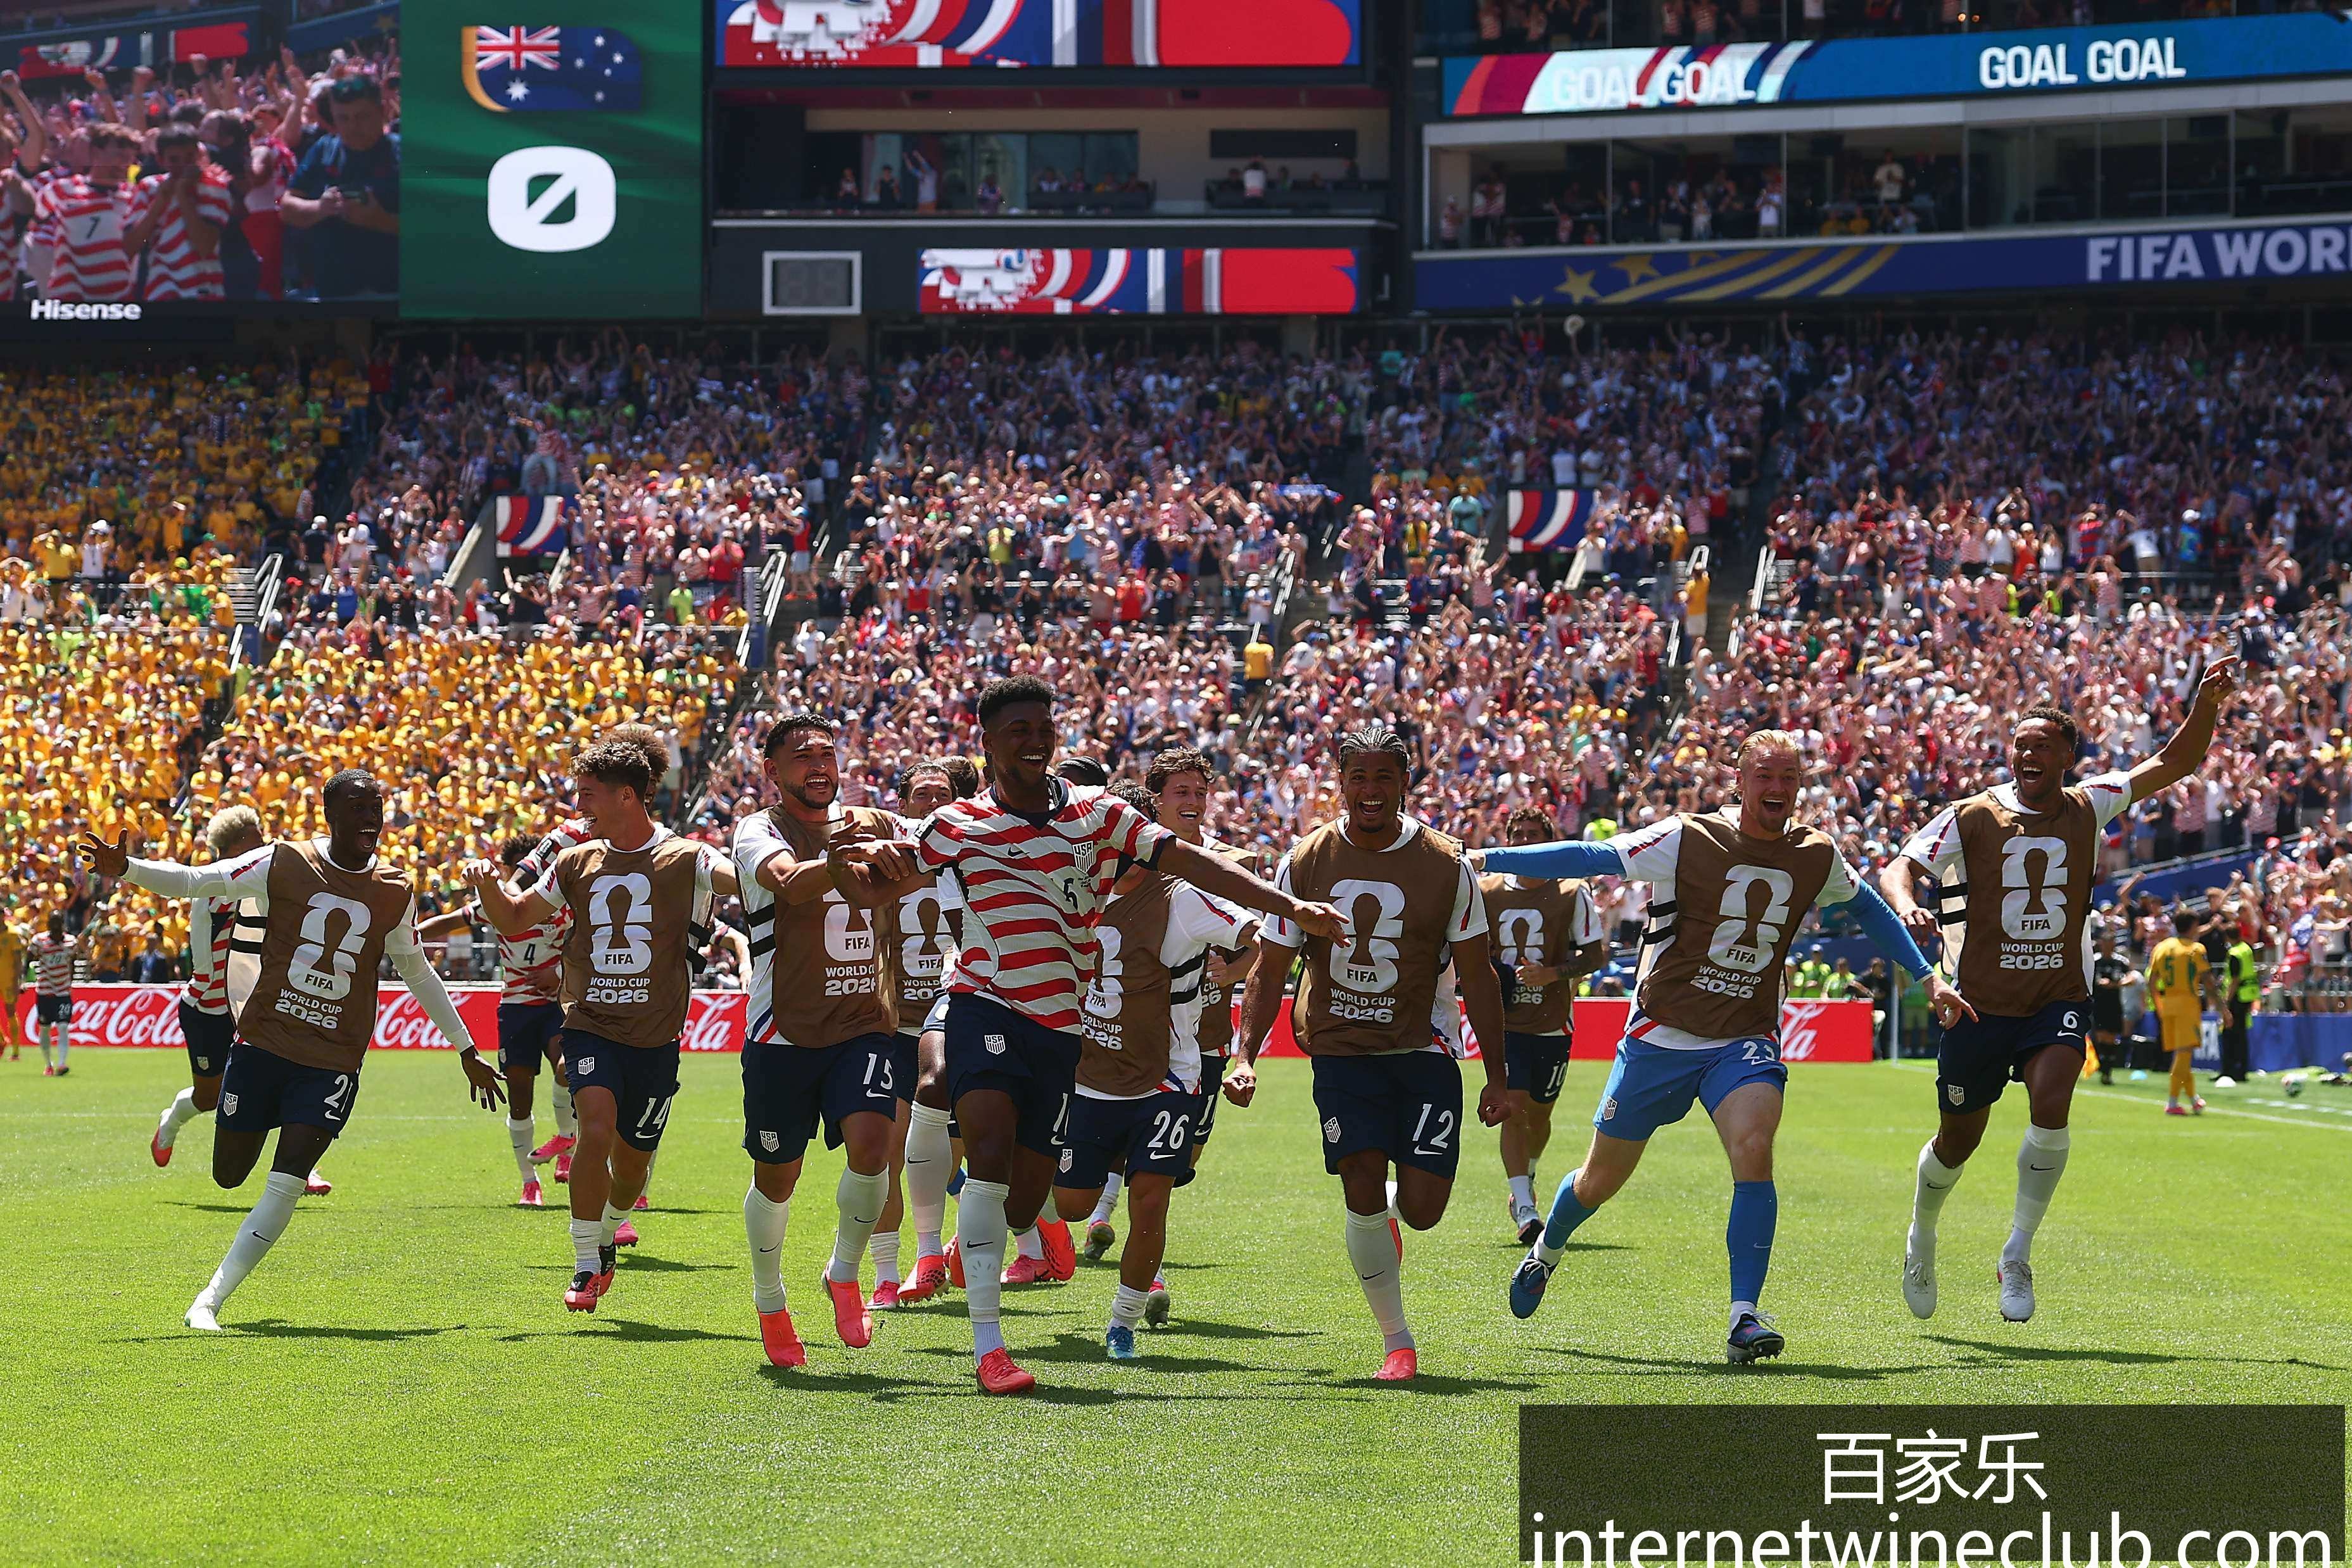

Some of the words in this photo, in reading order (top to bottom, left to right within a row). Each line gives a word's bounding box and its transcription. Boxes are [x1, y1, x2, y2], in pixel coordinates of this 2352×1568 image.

[1980, 42, 2078, 89] GOAL
[2088, 37, 2187, 82] GOAL
[1553, 65, 1647, 106] GOAL
[1660, 61, 1756, 104] GOAL
[488, 146, 616, 251] 0
[2087, 234, 2205, 282] FIFA
[2213, 227, 2352, 277] WOR
[31, 300, 142, 320] Hisense
[1074, 842, 1092, 856] USA
[2021, 920, 2051, 930] FIFA
[845, 937, 870, 950] FIFA
[2001, 942, 2043, 952] WORLD
[2044, 942, 2064, 952] CUP
[524, 944, 536, 964] 4
[605, 954, 634, 964] FIFA
[1726, 948, 1755, 964] FIFA
[2000, 954, 2063, 970] 2026
[825, 964, 868, 977] WORLD
[1346, 968, 1378, 982] FIFA
[1698, 966, 1740, 982] WORLD
[1742, 975, 1762, 985] CUP
[305, 973, 334, 991] FIFA
[590, 977, 628, 988] WORLD
[628, 977, 650, 987] CUP
[1690, 976, 1754, 999] 2026
[280, 988, 320, 1009] WORLD
[321, 1002, 343, 1015] CUP
[585, 988, 649, 1004] 2026
[904, 988, 934, 1000] 20
[1330, 988, 1369, 1006] WORLD
[1370, 996, 1396, 1007] CUP
[275, 999, 338, 1029] 2026
[1329, 1000, 1393, 1023] 2026
[2063, 1011, 2080, 1028] 6
[1103, 1023, 1123, 1034] CUP
[985, 1035, 1002, 1044] USA
[1082, 1024, 1123, 1050] 026
[1742, 1041, 1776, 1061] 23
[579, 1058, 594, 1066] USA
[863, 1053, 893, 1089] 15
[225, 1092, 238, 1103] USA
[1949, 1085, 1963, 1095] USA
[637, 1096, 671, 1130] 14
[1147, 1110, 1189, 1149] 26
[1324, 1119, 1337, 1132] USA
[1412, 1104, 1454, 1148] 12
[760, 1131, 778, 1141] USA
[1063, 1149, 1072, 1159] SA
